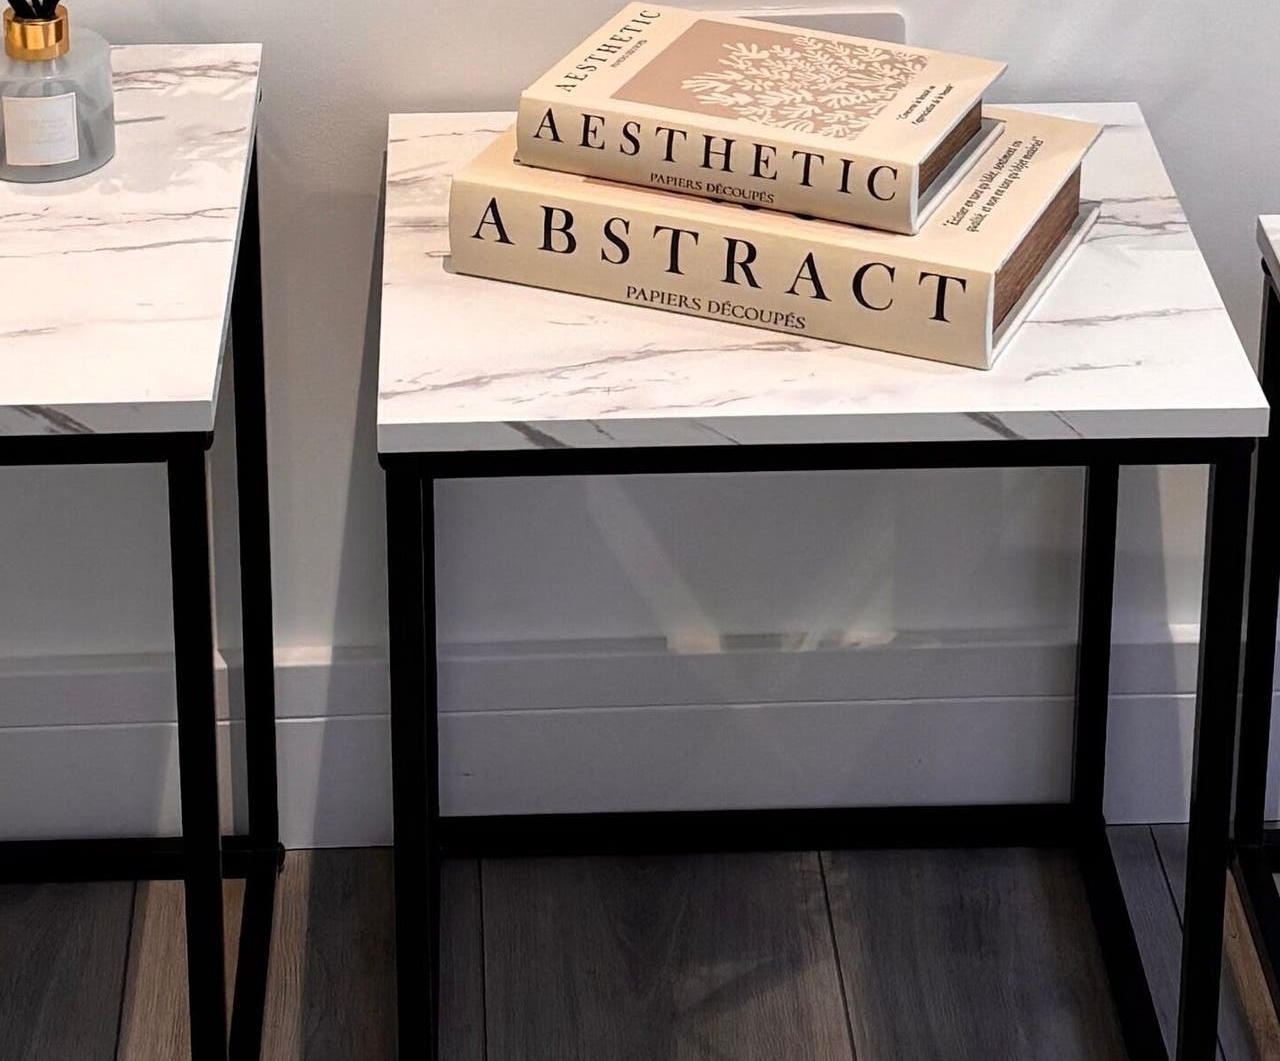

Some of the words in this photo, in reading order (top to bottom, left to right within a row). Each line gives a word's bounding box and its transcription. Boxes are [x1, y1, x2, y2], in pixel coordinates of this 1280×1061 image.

[555, 10, 661, 92] AESTHETIC
[533, 107, 899, 202] AESTHETIC
[650, 172, 703, 191] PAPIERS
[705, 183, 775, 204] DÉCOUPÉS
[472, 195, 968, 324] ABSTRACT
[626, 285, 702, 311] PAPIERS
[707, 300, 806, 330] DÉCOUPÉS
